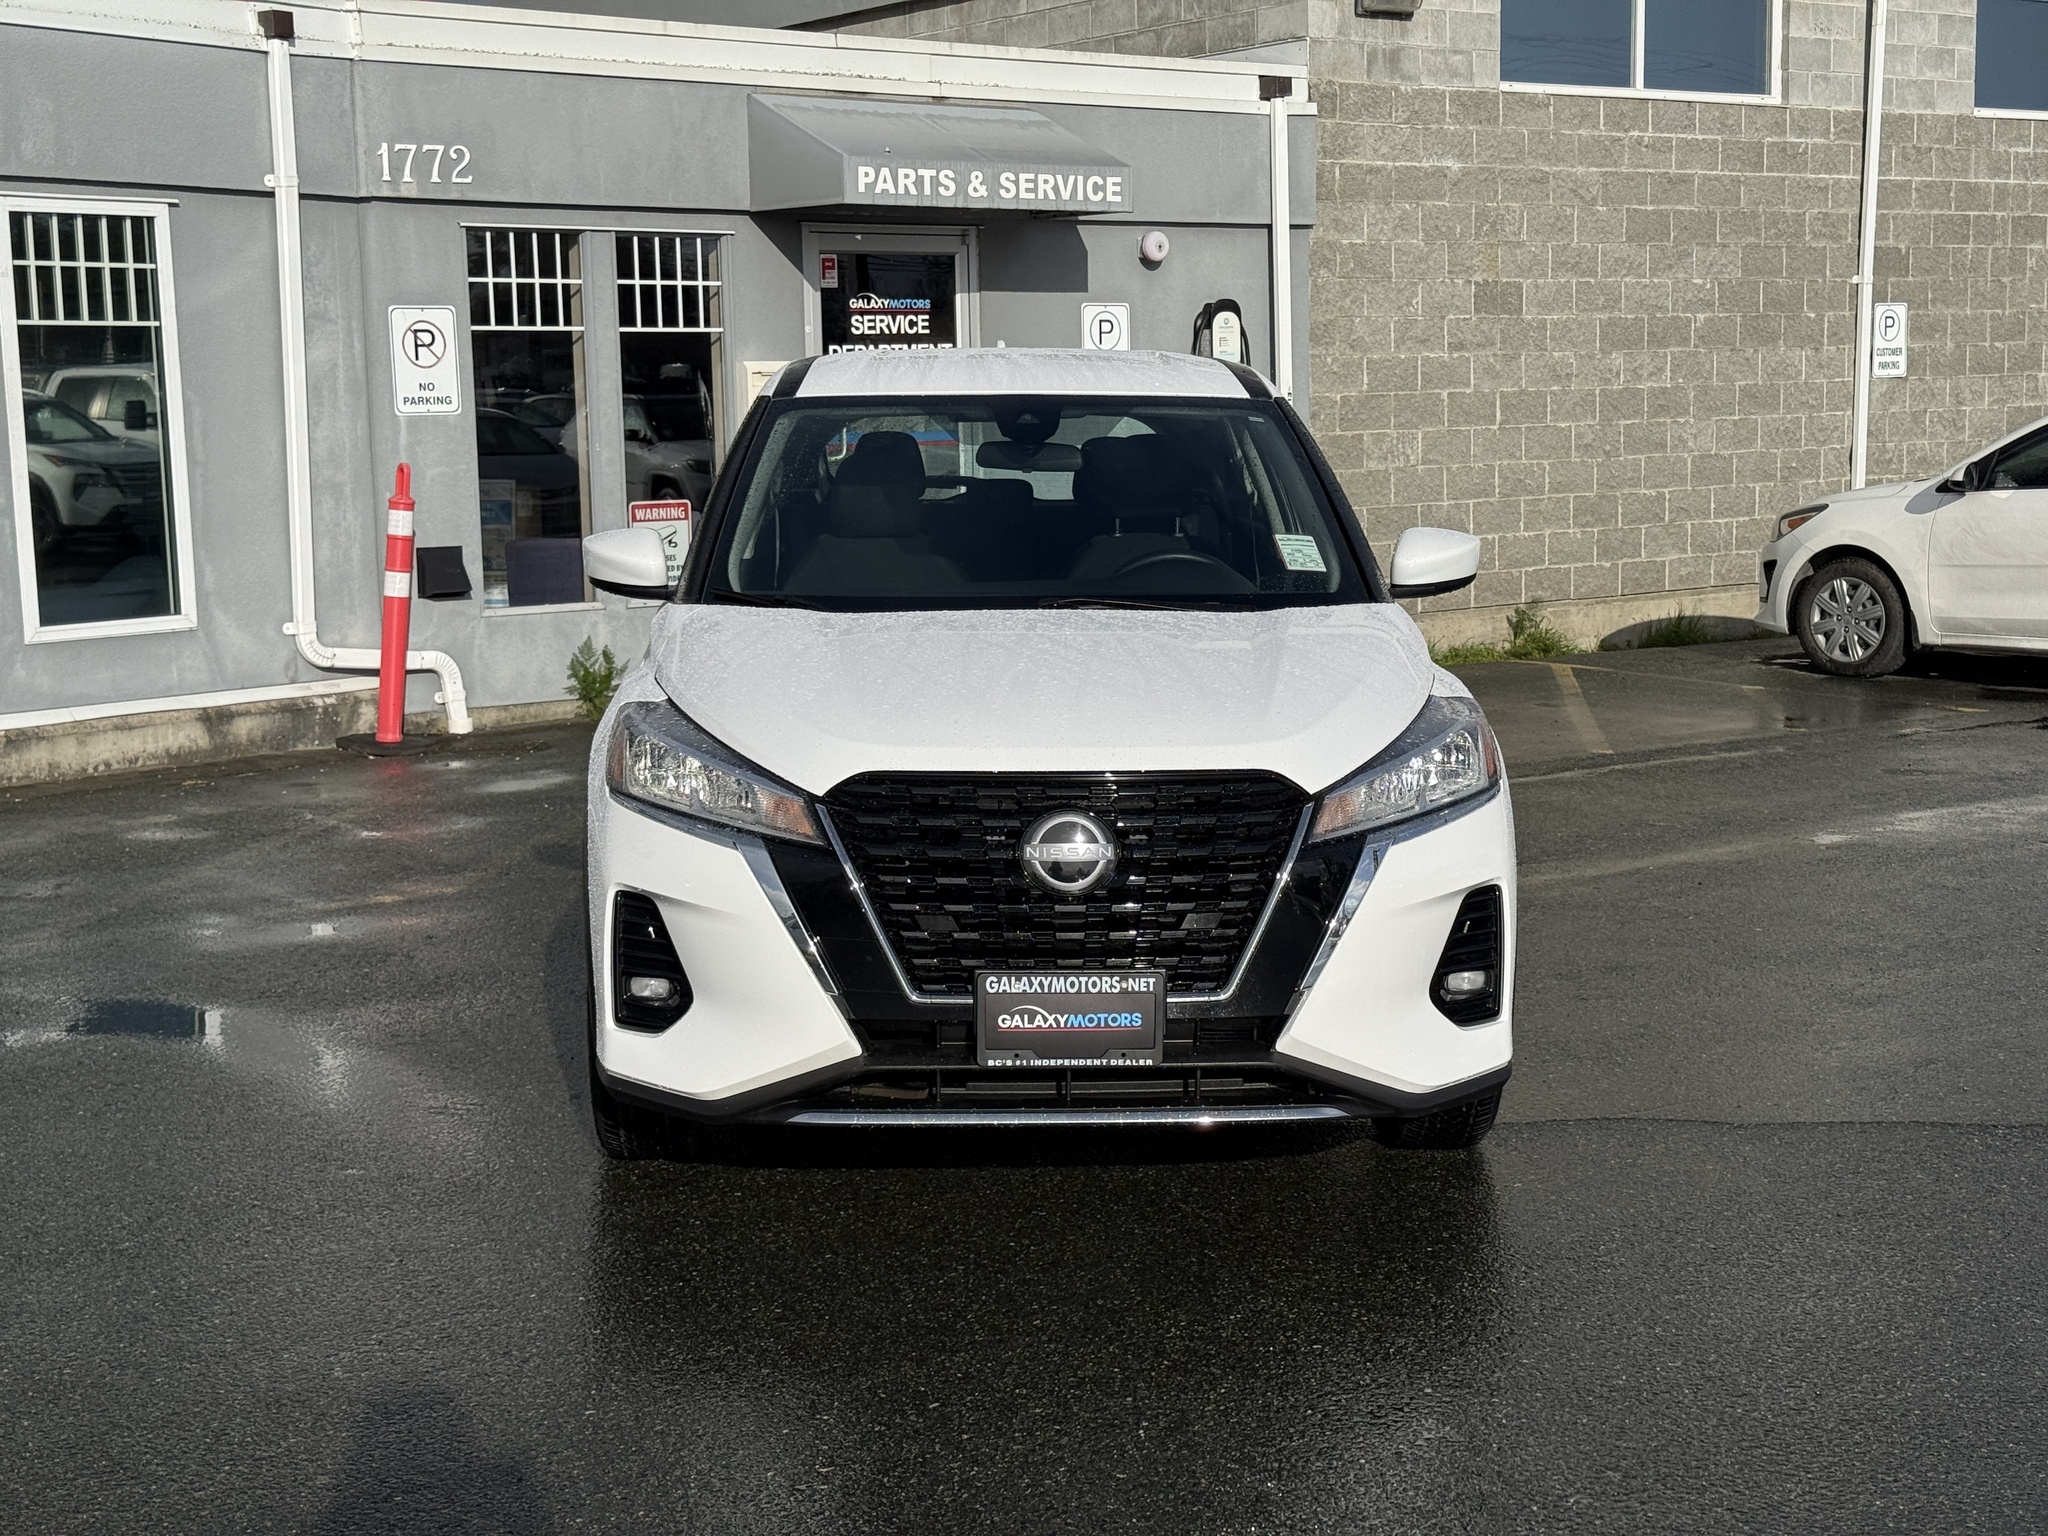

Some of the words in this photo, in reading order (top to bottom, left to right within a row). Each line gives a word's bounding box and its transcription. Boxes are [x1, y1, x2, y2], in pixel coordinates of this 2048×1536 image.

[376, 142, 474, 184] 1772
[857, 165, 957, 197] PARTS
[967, 170, 989, 198] &
[999, 171, 1122, 202] SERVICE
[849, 298, 931, 309] GALAXYMOTORS
[851, 314, 930, 335] SERVICE
[1876, 348, 1902, 356] CUSTOMER
[1878, 361, 1900, 370] PARKING
[418, 382, 436, 392] NO
[403, 395, 453, 406] PARKING
[635, 507, 686, 520] WARNING
[1025, 845, 1112, 859] NISSAN
[997, 1012, 1143, 1029] GALAXYMOTORS
[987, 1059, 1013, 1067] BC'S
[1015, 1059, 1027, 1067] #1
[1110, 1058, 1153, 1066] DEALER
